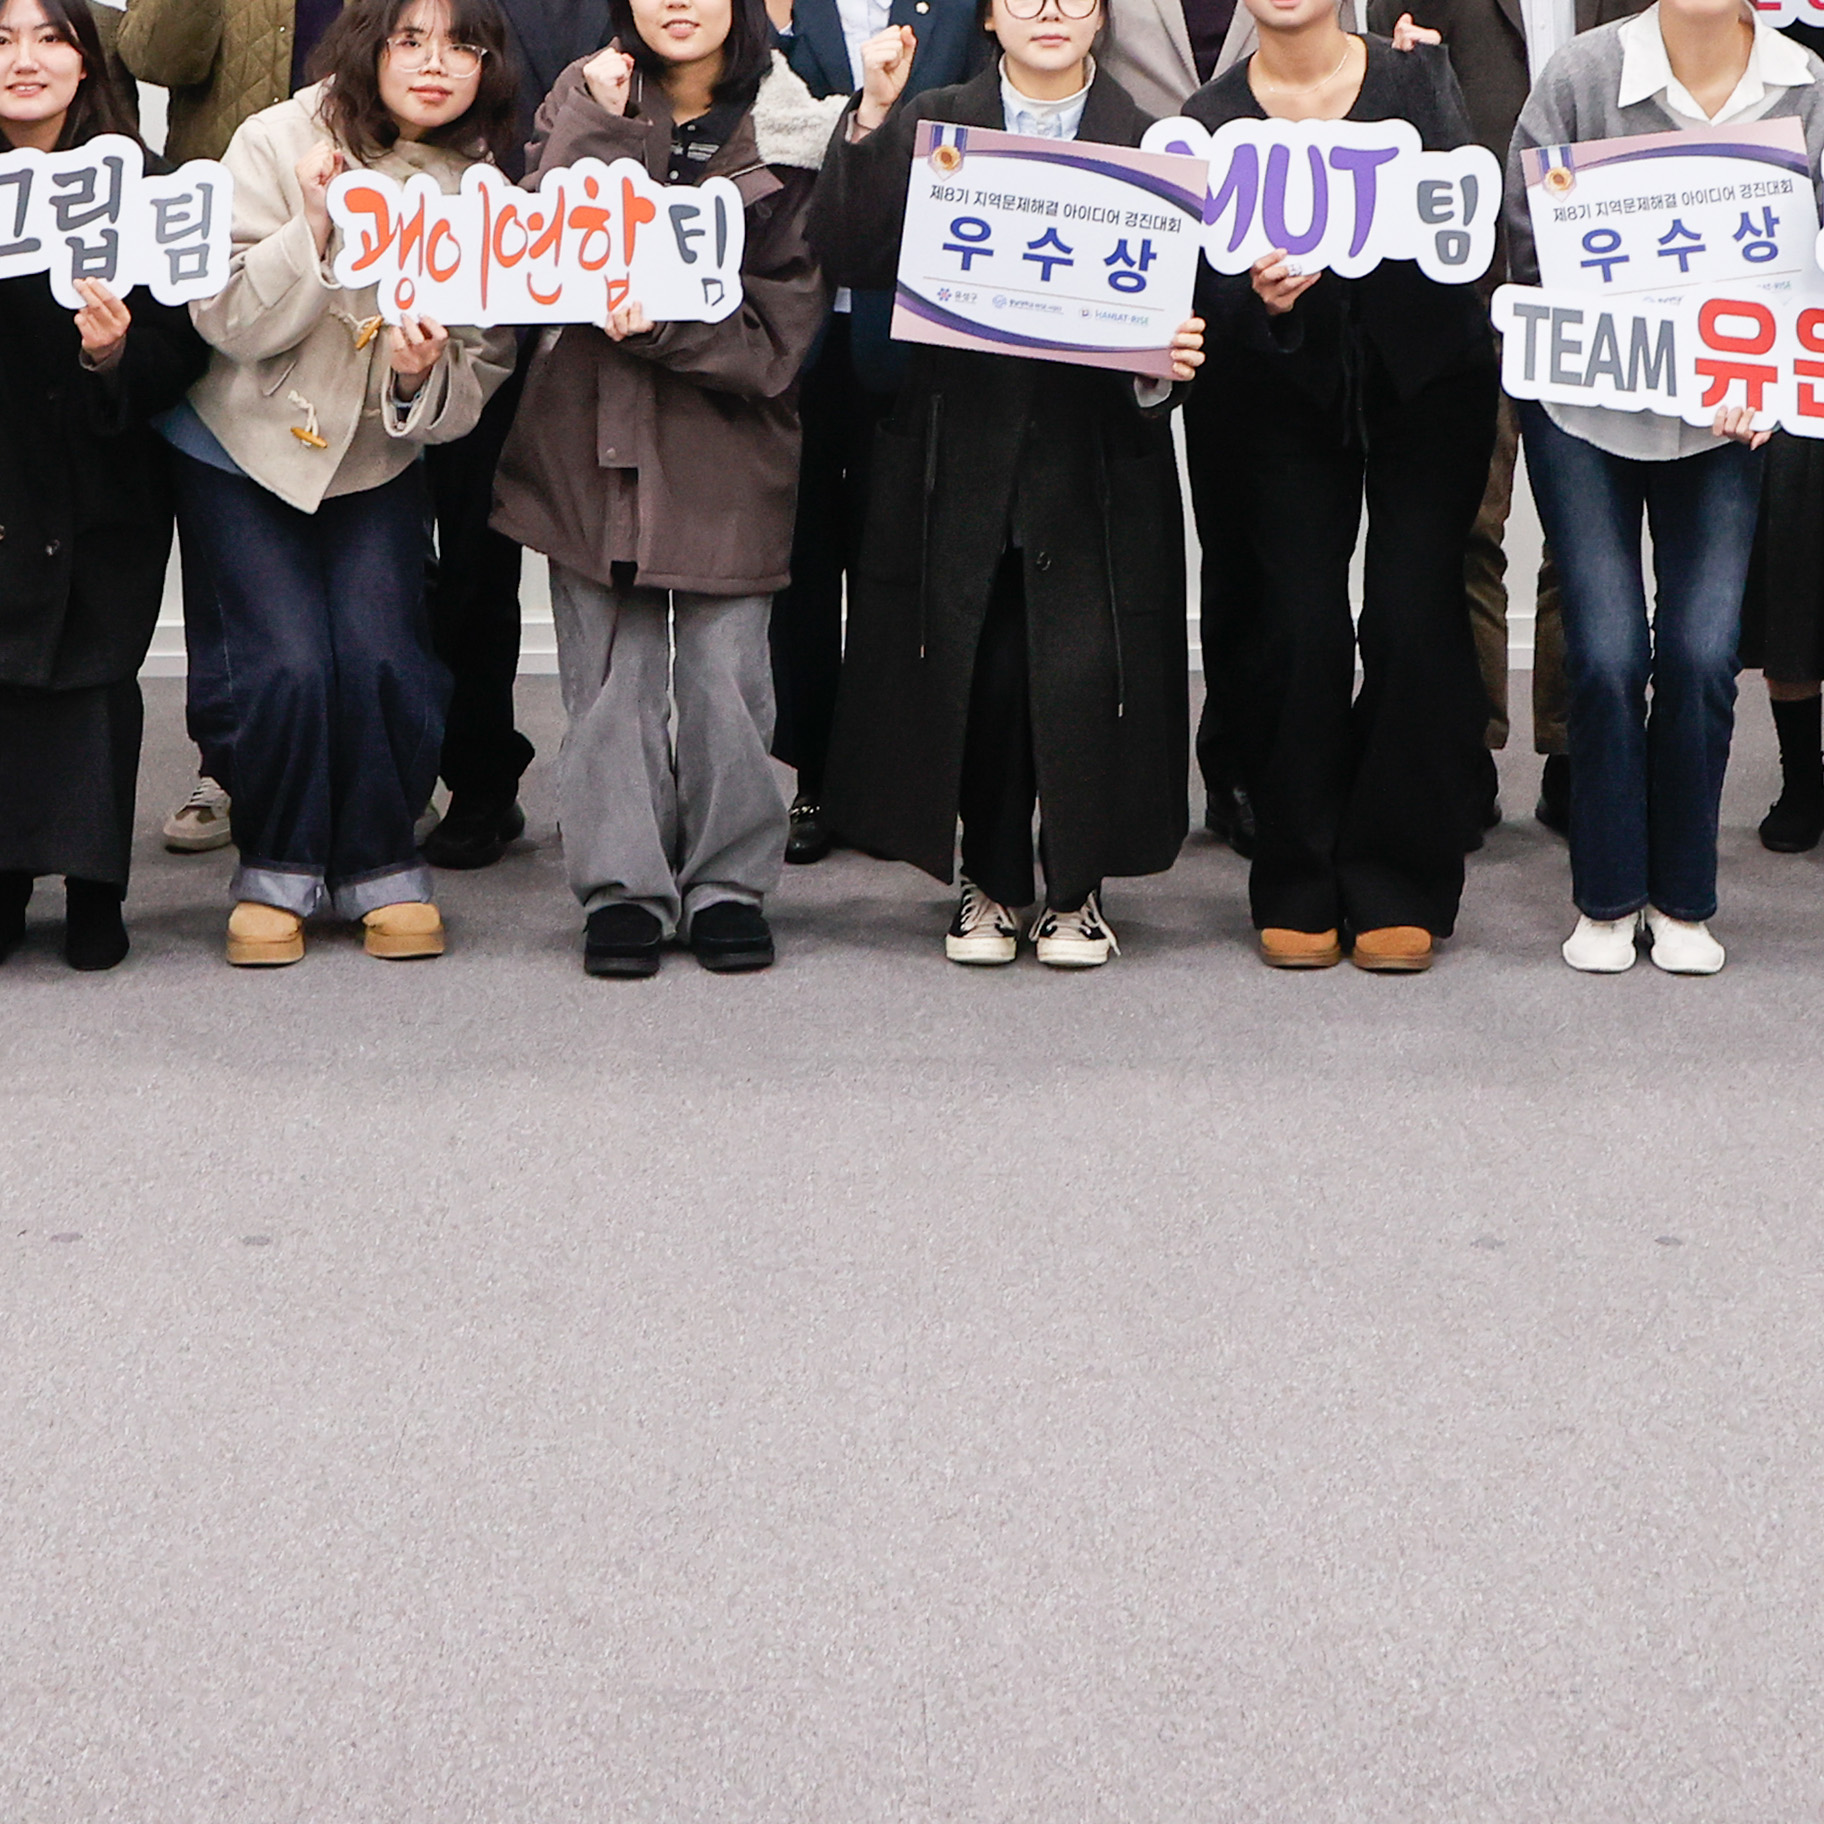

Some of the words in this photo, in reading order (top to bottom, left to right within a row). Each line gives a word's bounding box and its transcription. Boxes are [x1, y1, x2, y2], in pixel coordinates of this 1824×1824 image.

[150, 180, 214, 286] 팀
[930, 184, 969, 204] 제8기
[973, 191, 1059, 218] 지역문제해결
[1063, 204, 1120, 225] 아이디어
[1124, 211, 1182, 234] 경진대회
[1416, 174, 1479, 266] 팀
[1553, 204, 1592, 222] 제8기
[1595, 193, 1677, 218] 지역문제해결
[1681, 185, 1736, 206] 아이디어
[1740, 178, 1794, 199] 경진대회
[668, 196, 728, 306] 팀
[1512, 302, 1678, 398] TEAM
